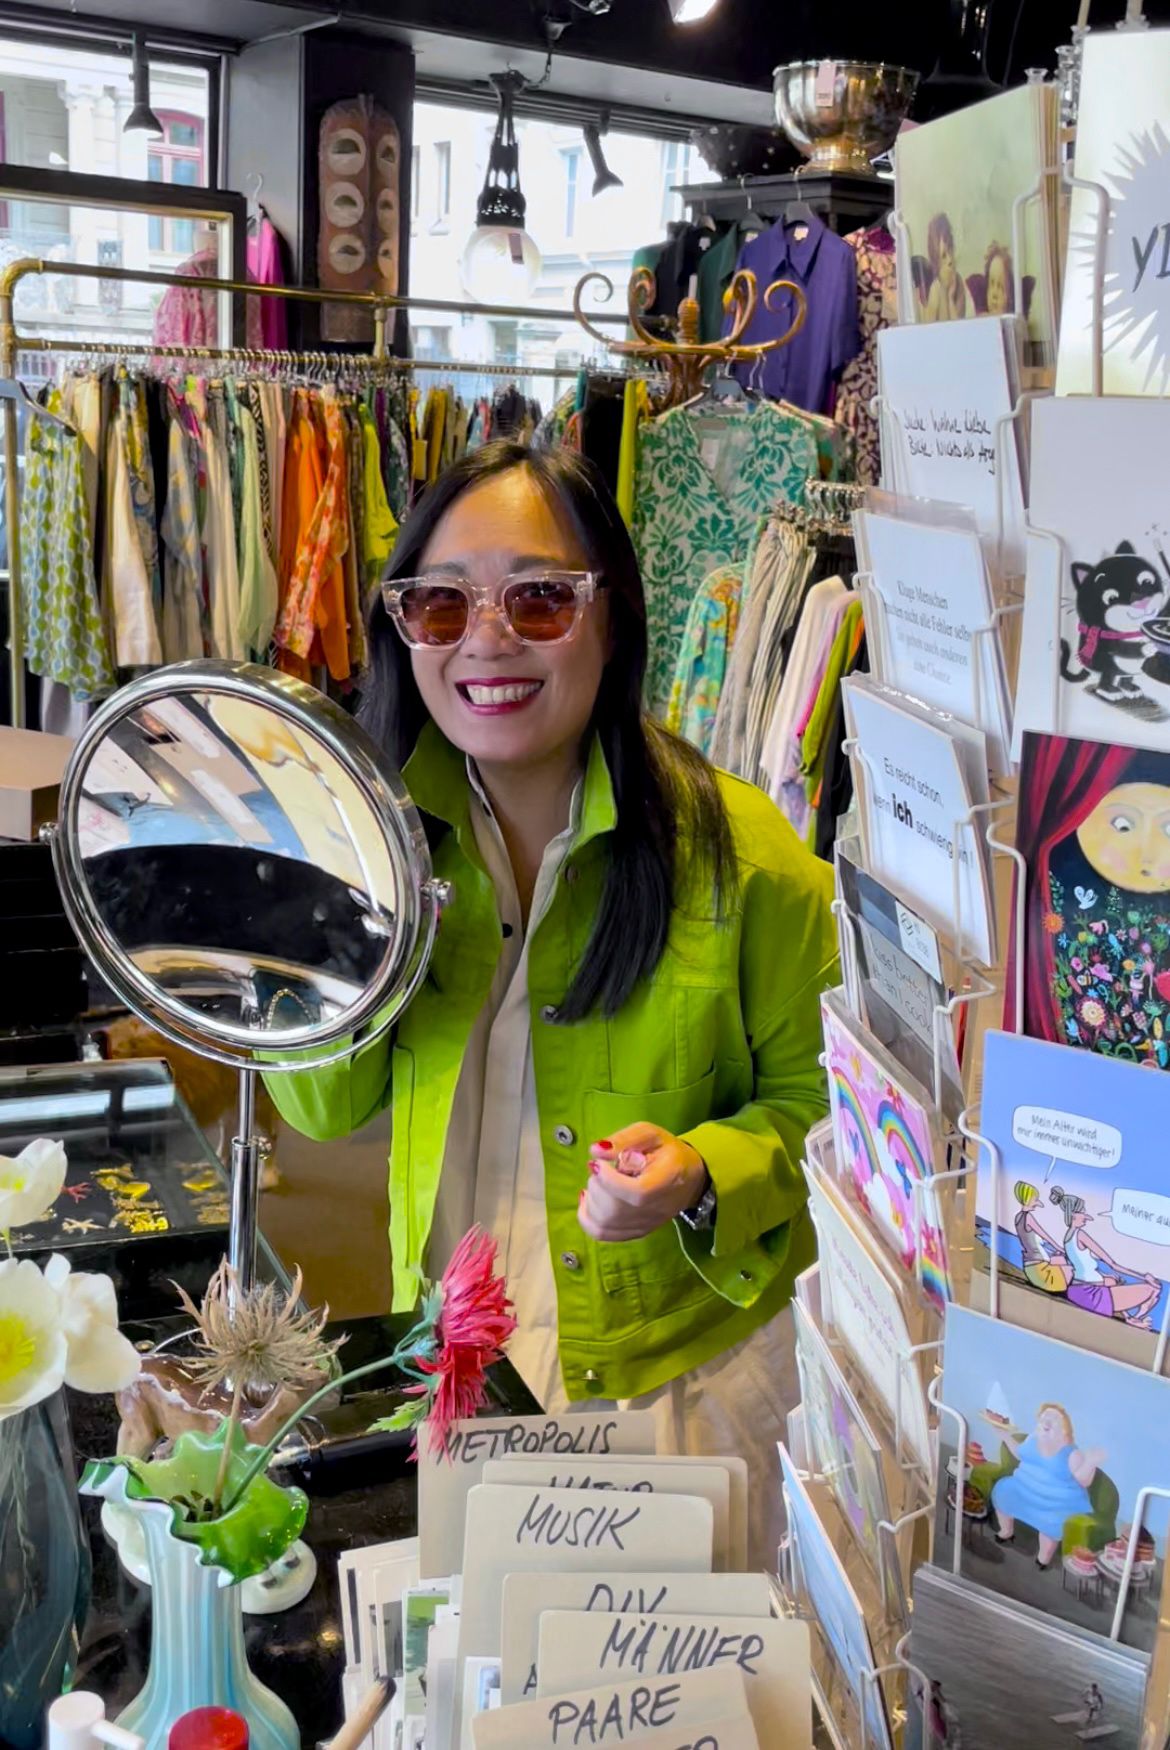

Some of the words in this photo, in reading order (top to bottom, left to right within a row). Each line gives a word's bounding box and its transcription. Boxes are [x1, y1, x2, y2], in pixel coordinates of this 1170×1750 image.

[915, 585, 948, 610] Menschen
[883, 757, 894, 777] Es
[895, 767, 917, 790] reicht
[892, 792, 913, 829] ich
[1031, 1114, 1052, 1129] Mein
[1077, 1126, 1098, 1141] wird
[436, 1420, 618, 1466] METROPOLIS
[516, 1493, 641, 1551] MUSIK
[599, 1617, 764, 1676] MÄNNER
[548, 1683, 681, 1746] PAARE
